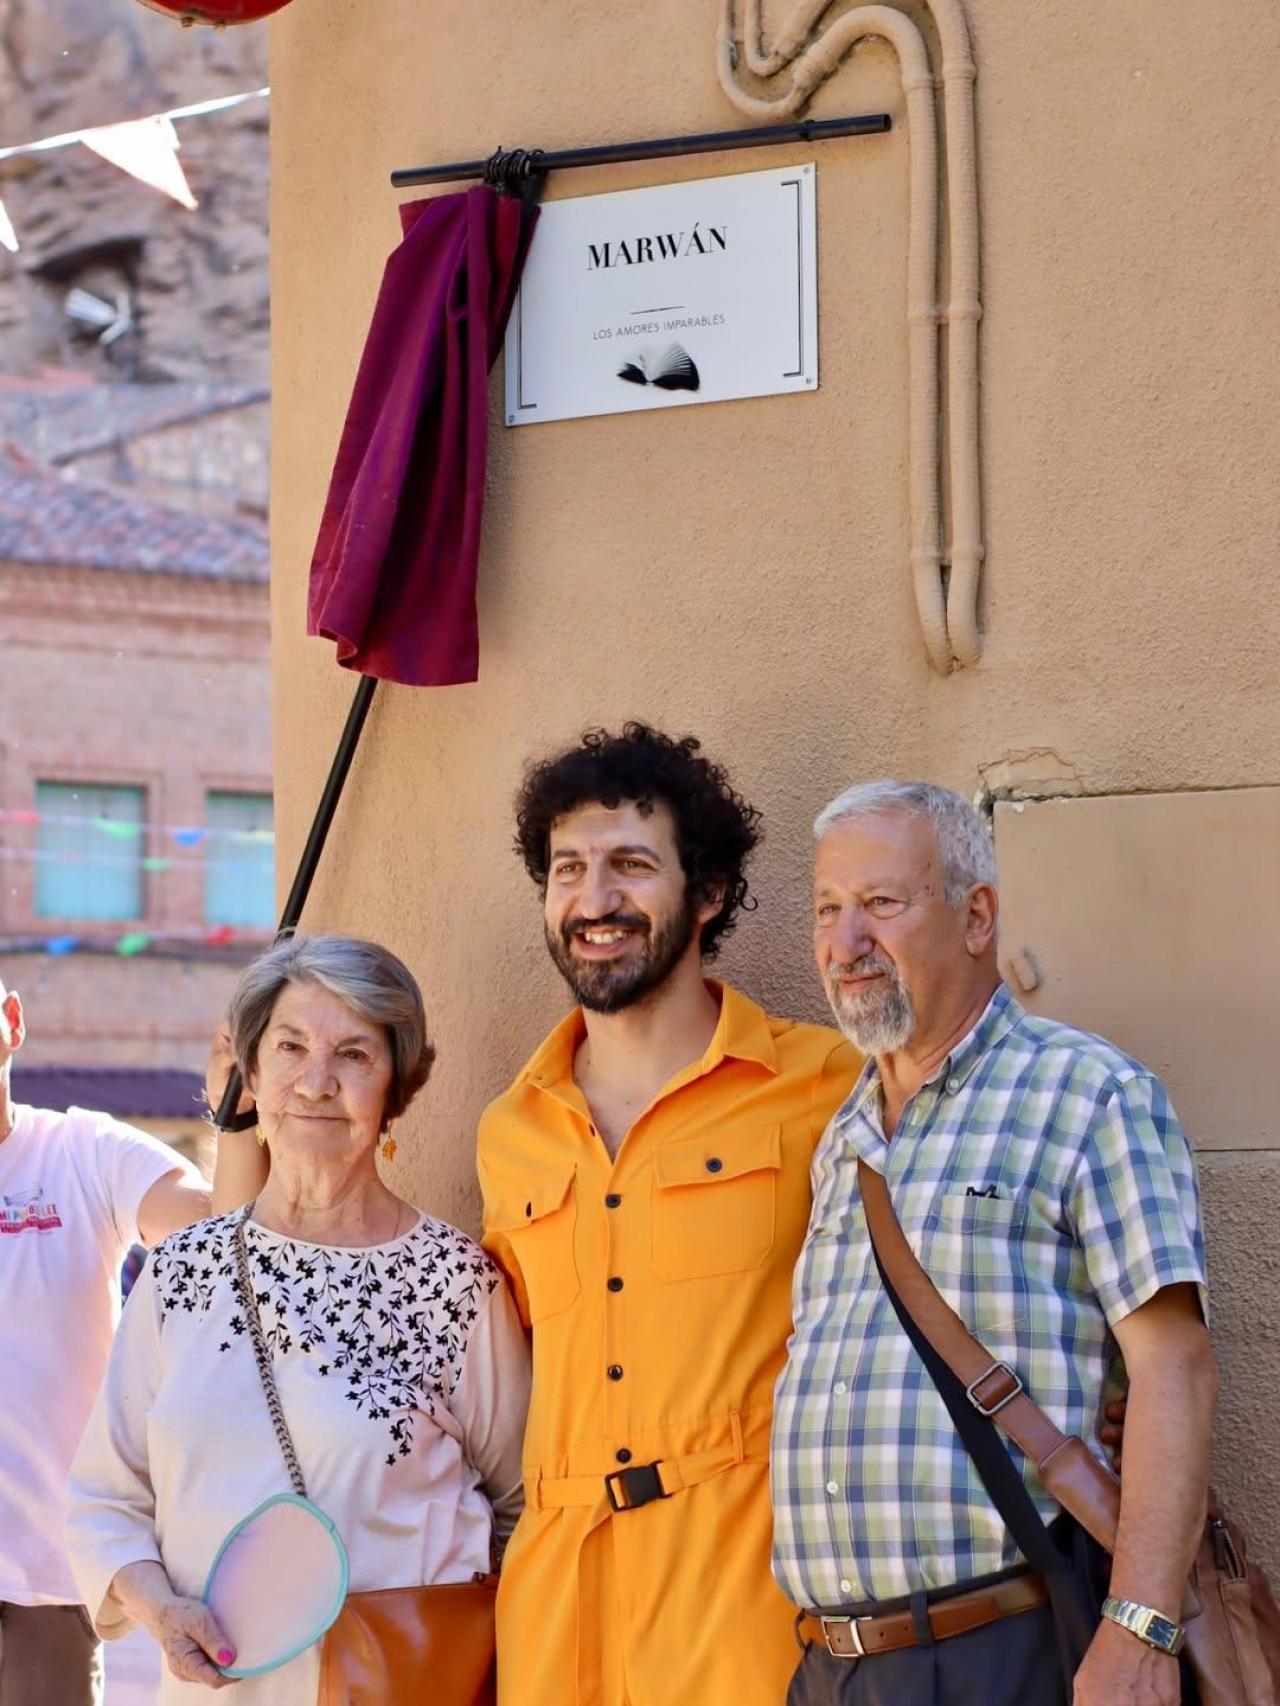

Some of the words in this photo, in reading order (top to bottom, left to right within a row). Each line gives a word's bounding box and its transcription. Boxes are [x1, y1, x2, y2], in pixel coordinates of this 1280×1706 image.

[587, 222, 729, 271] MARWÁN
[592, 329, 613, 340] LOS
[616, 322, 660, 338] AMORES
[663, 313, 726, 331] IMPARABLES
